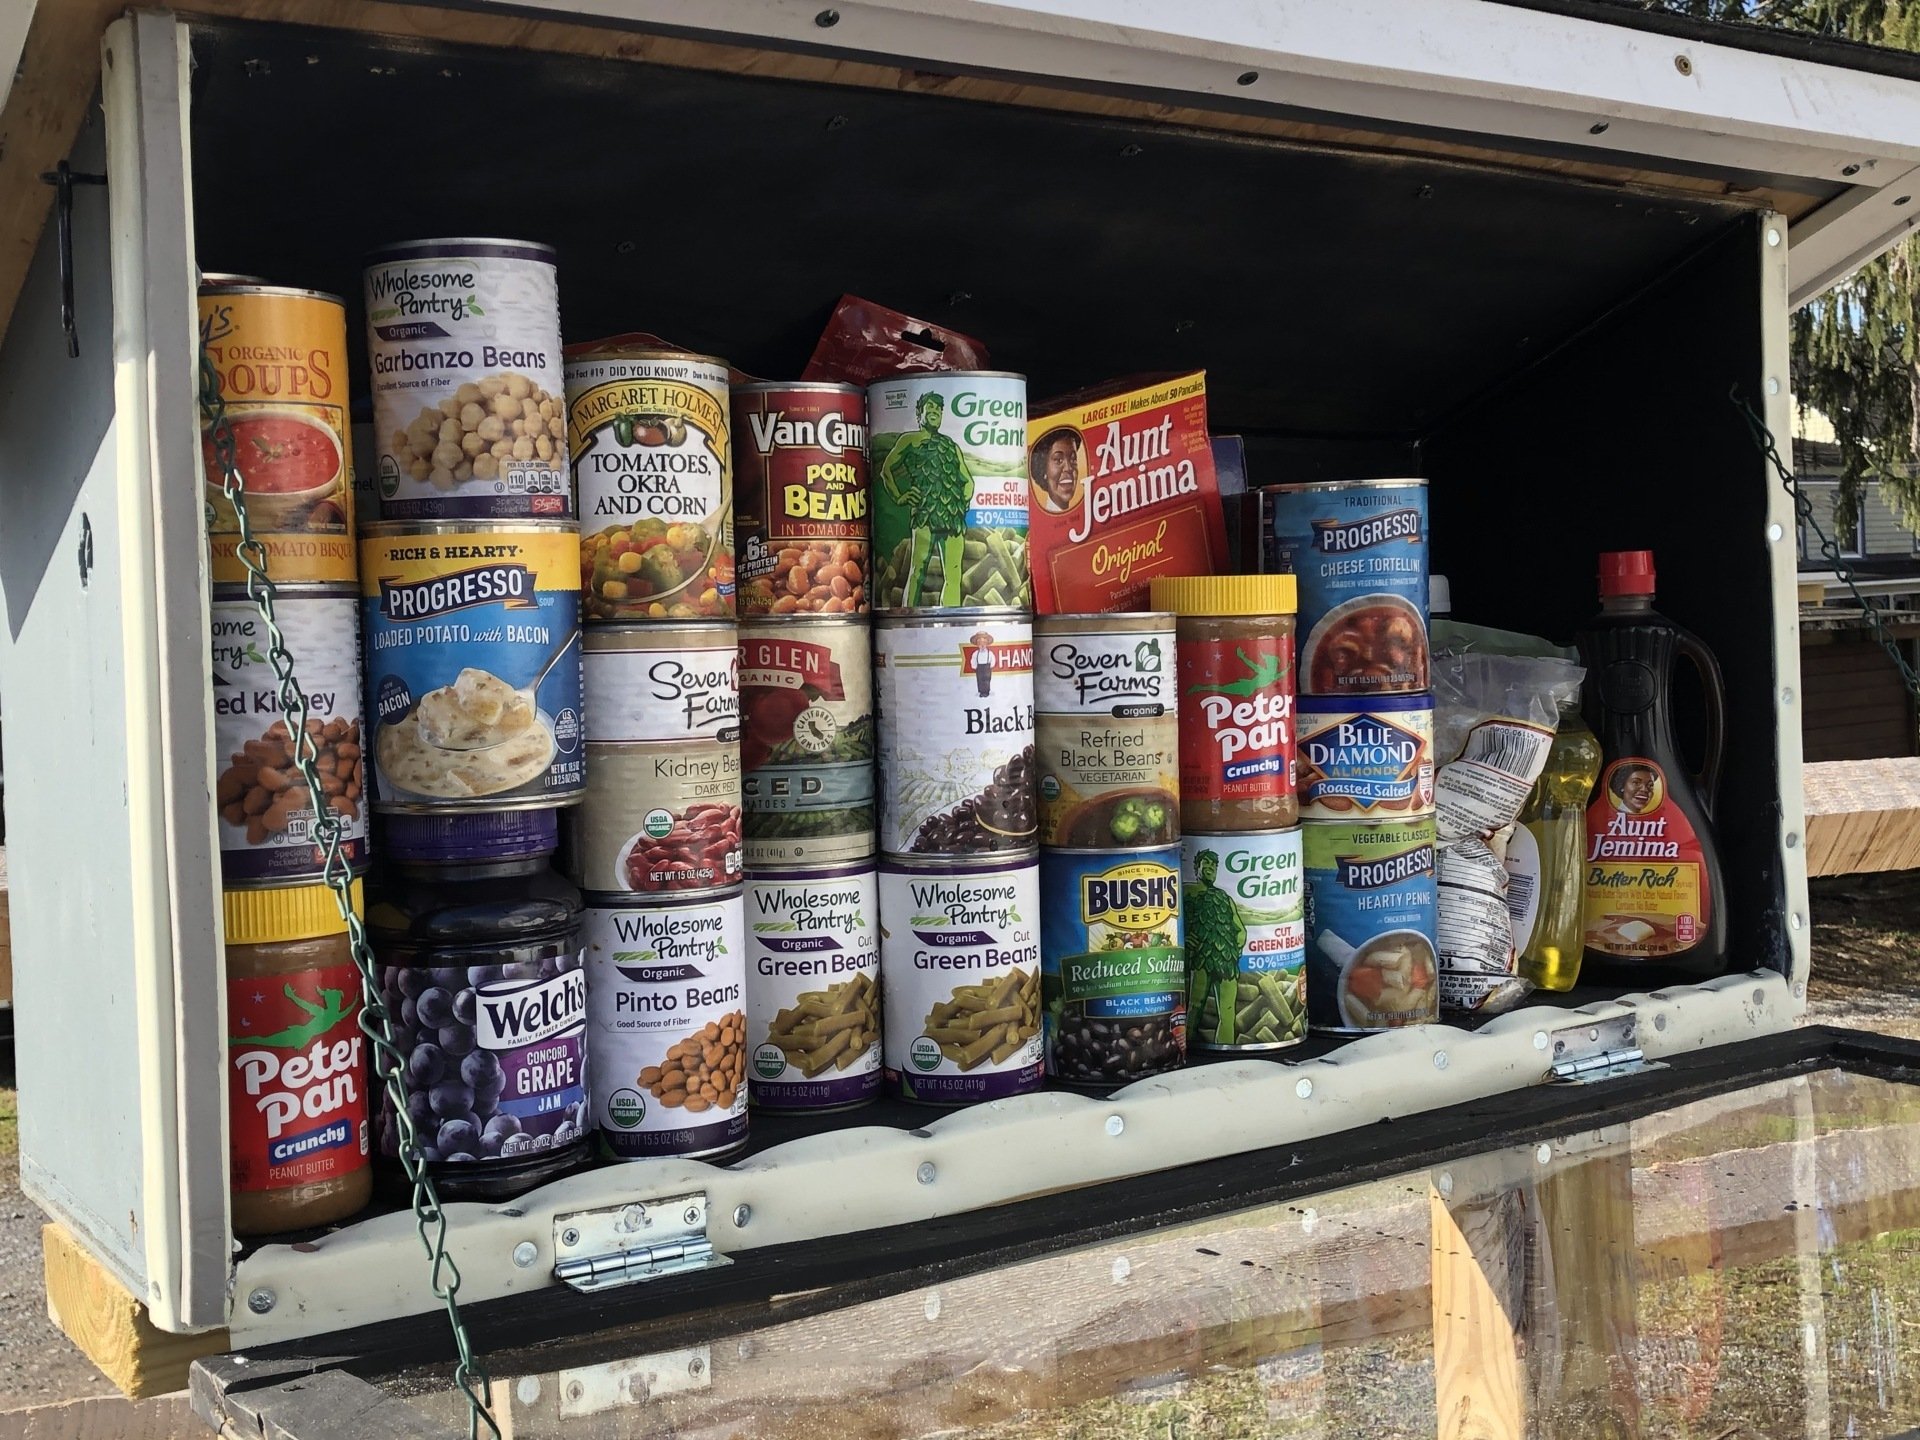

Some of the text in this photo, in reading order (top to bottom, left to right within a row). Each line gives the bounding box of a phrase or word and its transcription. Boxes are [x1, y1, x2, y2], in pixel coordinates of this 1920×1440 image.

[371, 268, 475, 302] Wholesome
[394, 291, 464, 321] Pantry
[389, 325, 428, 339] Organic
[375, 346, 546, 375] Garbanzo Beans
[610, 366, 688, 378] DID YOU KNOW?
[398, 378, 451, 391] Source of Fiber
[577, 387, 720, 428] MARGARET HOLMES
[950, 391, 1024, 420] Green
[1082, 382, 1204, 426] LARGE SIZE Makes About 50 Pancakes
[749, 411, 815, 454] Van
[963, 420, 1025, 447] Giant
[1095, 414, 1173, 479] Aunt
[591, 453, 712, 476] TOMATOES,
[806, 462, 858, 488] PORK
[617, 474, 683, 494] OKRA
[826, 482, 845, 491] AND
[1003, 481, 1019, 492] CUT
[594, 496, 707, 516] AND CORN
[784, 484, 867, 522] BEANS
[975, 492, 1013, 506] GREEN
[1068, 458, 1199, 545] Jemima
[1343, 495, 1403, 508] TRADITIONAL
[781, 524, 847, 536] IN TOMATO
[975, 511, 1006, 526] 50%
[1322, 513, 1418, 552] PROGRESSO
[389, 545, 518, 561] RICH & HEARTY
[747, 535, 768, 560] 6G
[1092, 519, 1168, 584] Original
[747, 556, 778, 572] PROTEIN
[1320, 556, 1421, 578] CHEESE TORTELLINI
[389, 569, 523, 617] PROGRESSO
[374, 624, 549, 651] LOADED POTATO with BACON
[758, 645, 819, 675] GLEN
[1049, 643, 1132, 680] Seven
[648, 660, 731, 702] Seven
[1074, 669, 1162, 706] Farms
[378, 692, 410, 717] BACON
[1122, 706, 1158, 718] organic
[1200, 691, 1293, 730] Peter
[797, 708, 834, 730] CALIFORNIA
[963, 705, 1025, 735] Black
[1080, 728, 1144, 748] Refried
[1214, 720, 1290, 763] Pan
[1338, 722, 1395, 748] BLUE
[1060, 748, 1162, 768] Black Beans
[1309, 740, 1417, 767] DIAMOND
[654, 756, 720, 781] Kidney
[1079, 771, 1147, 783] VEGETARIAN
[1226, 758, 1280, 779] Crunchy
[1331, 765, 1401, 779] ALMONDS
[695, 781, 735, 797] DARK RED
[1223, 782, 1271, 793] PEANUT BUTTER
[1317, 781, 1412, 799] Roasted Salted
[650, 816, 669, 824] USDA
[1607, 812, 1667, 838] Aunt
[1351, 829, 1431, 845] VEGETABLE CLASSICS
[1586, 833, 1681, 863] Jemima
[1117, 868, 1141, 876] SINCE
[1224, 850, 1297, 874] Green
[1347, 846, 1433, 888] PROGRESSO
[650, 869, 697, 883] NET WT 15 OZ
[1236, 873, 1299, 899] Giant
[1586, 866, 1679, 889] Butter Rich
[754, 888, 861, 915] Wholesome
[910, 883, 1016, 909] Wholesome
[1088, 874, 1178, 917] BUSH'S
[1357, 890, 1432, 912] HEARTY PENNE
[790, 908, 855, 934] Pantry
[944, 903, 1009, 930] Pantry
[1117, 911, 1161, 923] BEST
[613, 915, 723, 944] Wholesome
[936, 933, 978, 946] Organic
[1013, 930, 1031, 943] Cut
[1273, 926, 1292, 938] CUT
[650, 936, 719, 962] Pantry
[781, 938, 824, 952] Organic
[857, 935, 873, 948] Cut
[1248, 932, 1305, 952] GREEN BEANS
[757, 948, 880, 976] Green Beans
[914, 944, 1038, 970] Green Beans
[1247, 956, 1278, 970] 50%
[642, 967, 685, 981] Organic
[1071, 955, 1142, 983] Reduced
[483, 975, 584, 1040] Welch's
[615, 983, 739, 1013] Pinto Beans
[1105, 993, 1173, 1008] BLACK BEANS
[616, 1017, 691, 1029] Good Source of Fiber
[507, 1025, 559, 1046] FAMILY FARMER
[526, 1044, 568, 1066] CONCORD
[759, 1051, 779, 1060] USDA
[916, 1043, 936, 1054] USDA
[235, 1036, 362, 1096] Peter
[516, 1057, 575, 1095] GRAPE
[798, 1085, 808, 1097] OZ
[938, 1078, 987, 1091] 14.5 OZ (411g)
[256, 1073, 358, 1139] Pan
[538, 1093, 562, 1112] JAM
[615, 1098, 638, 1107] USDA
[274, 1125, 346, 1159] Crunchy
[660, 1131, 695, 1144] OZ (439g)
[269, 1158, 335, 1180] PEANUT BUTTER
